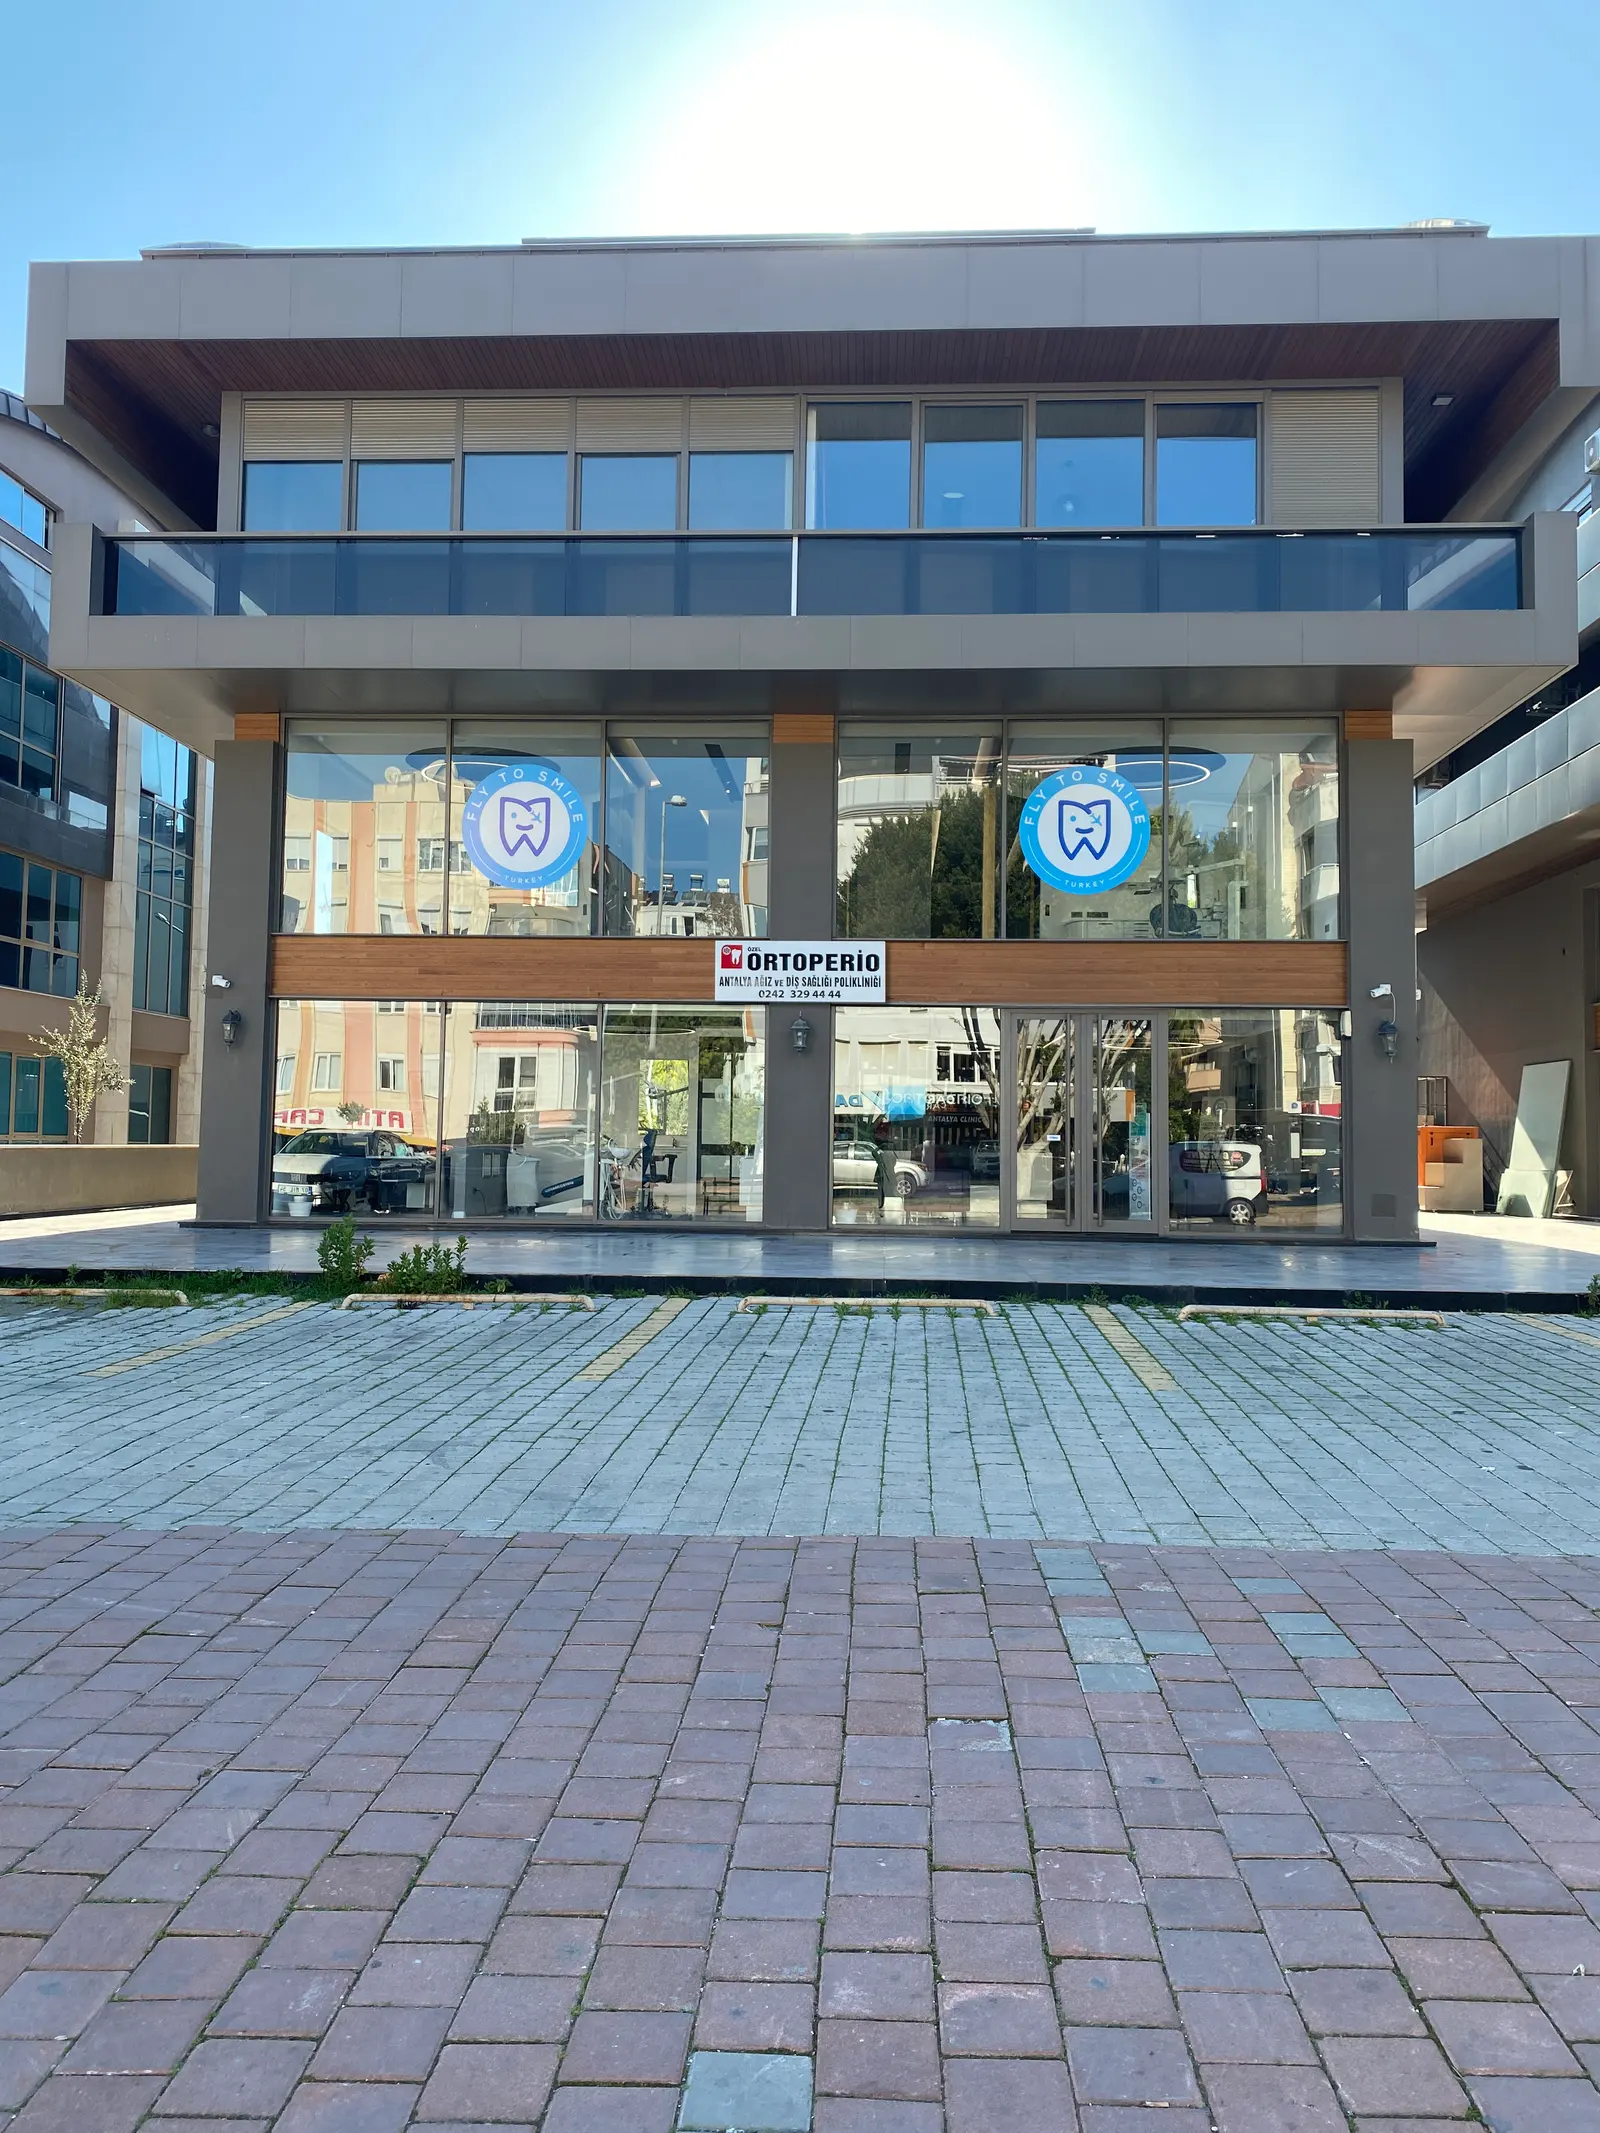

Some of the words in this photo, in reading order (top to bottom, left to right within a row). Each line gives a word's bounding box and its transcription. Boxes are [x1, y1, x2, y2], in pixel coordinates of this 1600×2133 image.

[467, 786, 489, 821] FLY
[498, 768, 524, 783] TO
[538, 770, 584, 823] SMILE
[1024, 789, 1047, 826] FLY
[1056, 770, 1083, 786] TO
[1097, 772, 1146, 825] SMILE
[503, 875, 543, 884] TURKEY
[1065, 880, 1105, 889] TURKEY
[747, 949, 880, 972] ORTOPERİO
[719, 976, 752, 987] ANTALYA
[754, 975, 773, 987] AĞIZ
[786, 975, 800, 989] DİŞ
[801, 975, 832, 987] SAĞLIĞI
[834, 975, 882, 988] POLİKLİNİĞİ
[758, 990, 785, 998] 0242
[790, 990, 810, 998] 329
[812, 990, 826, 998] 44
[827, 990, 842, 998] 44
